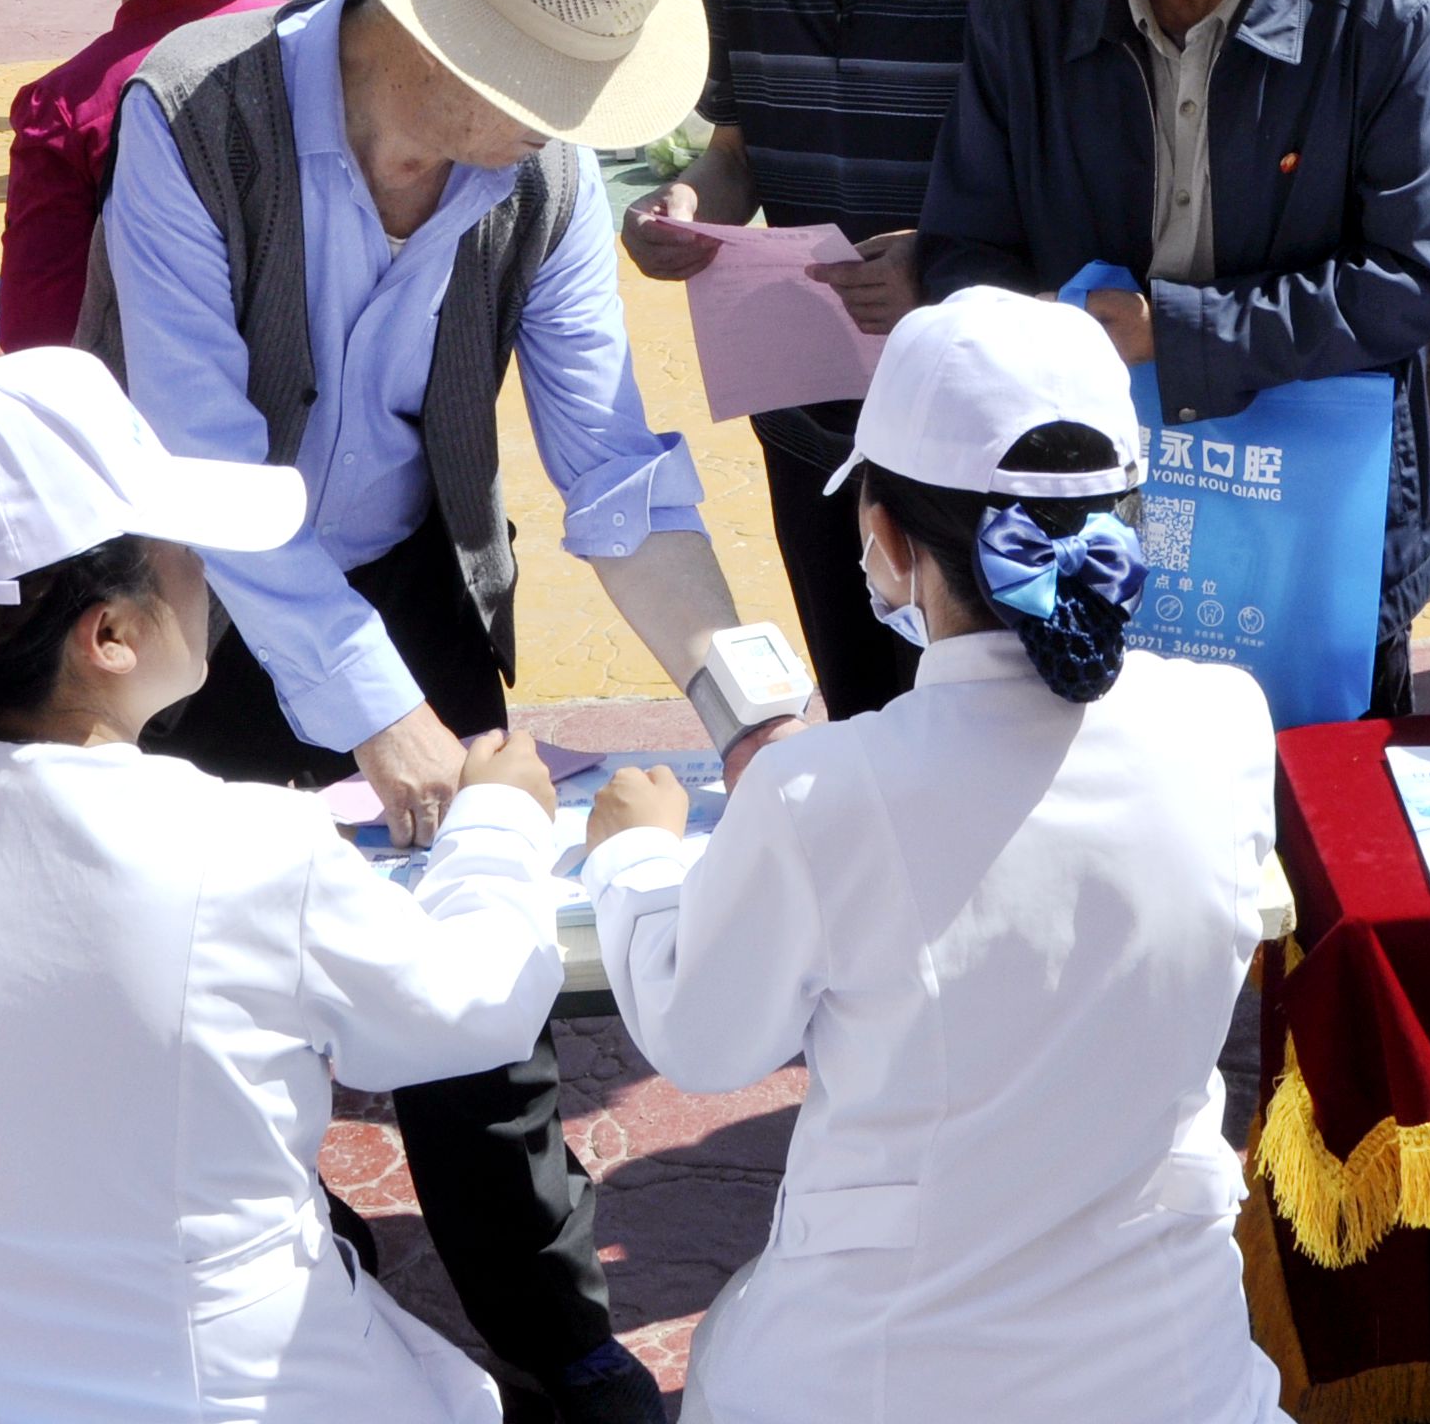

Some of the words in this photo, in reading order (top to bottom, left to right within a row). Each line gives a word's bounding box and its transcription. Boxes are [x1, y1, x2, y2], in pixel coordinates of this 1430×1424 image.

[1152, 469, 1196, 487] YONG
[1198, 473, 1230, 493] KOU
[1231, 484, 1283, 502] QIANG
